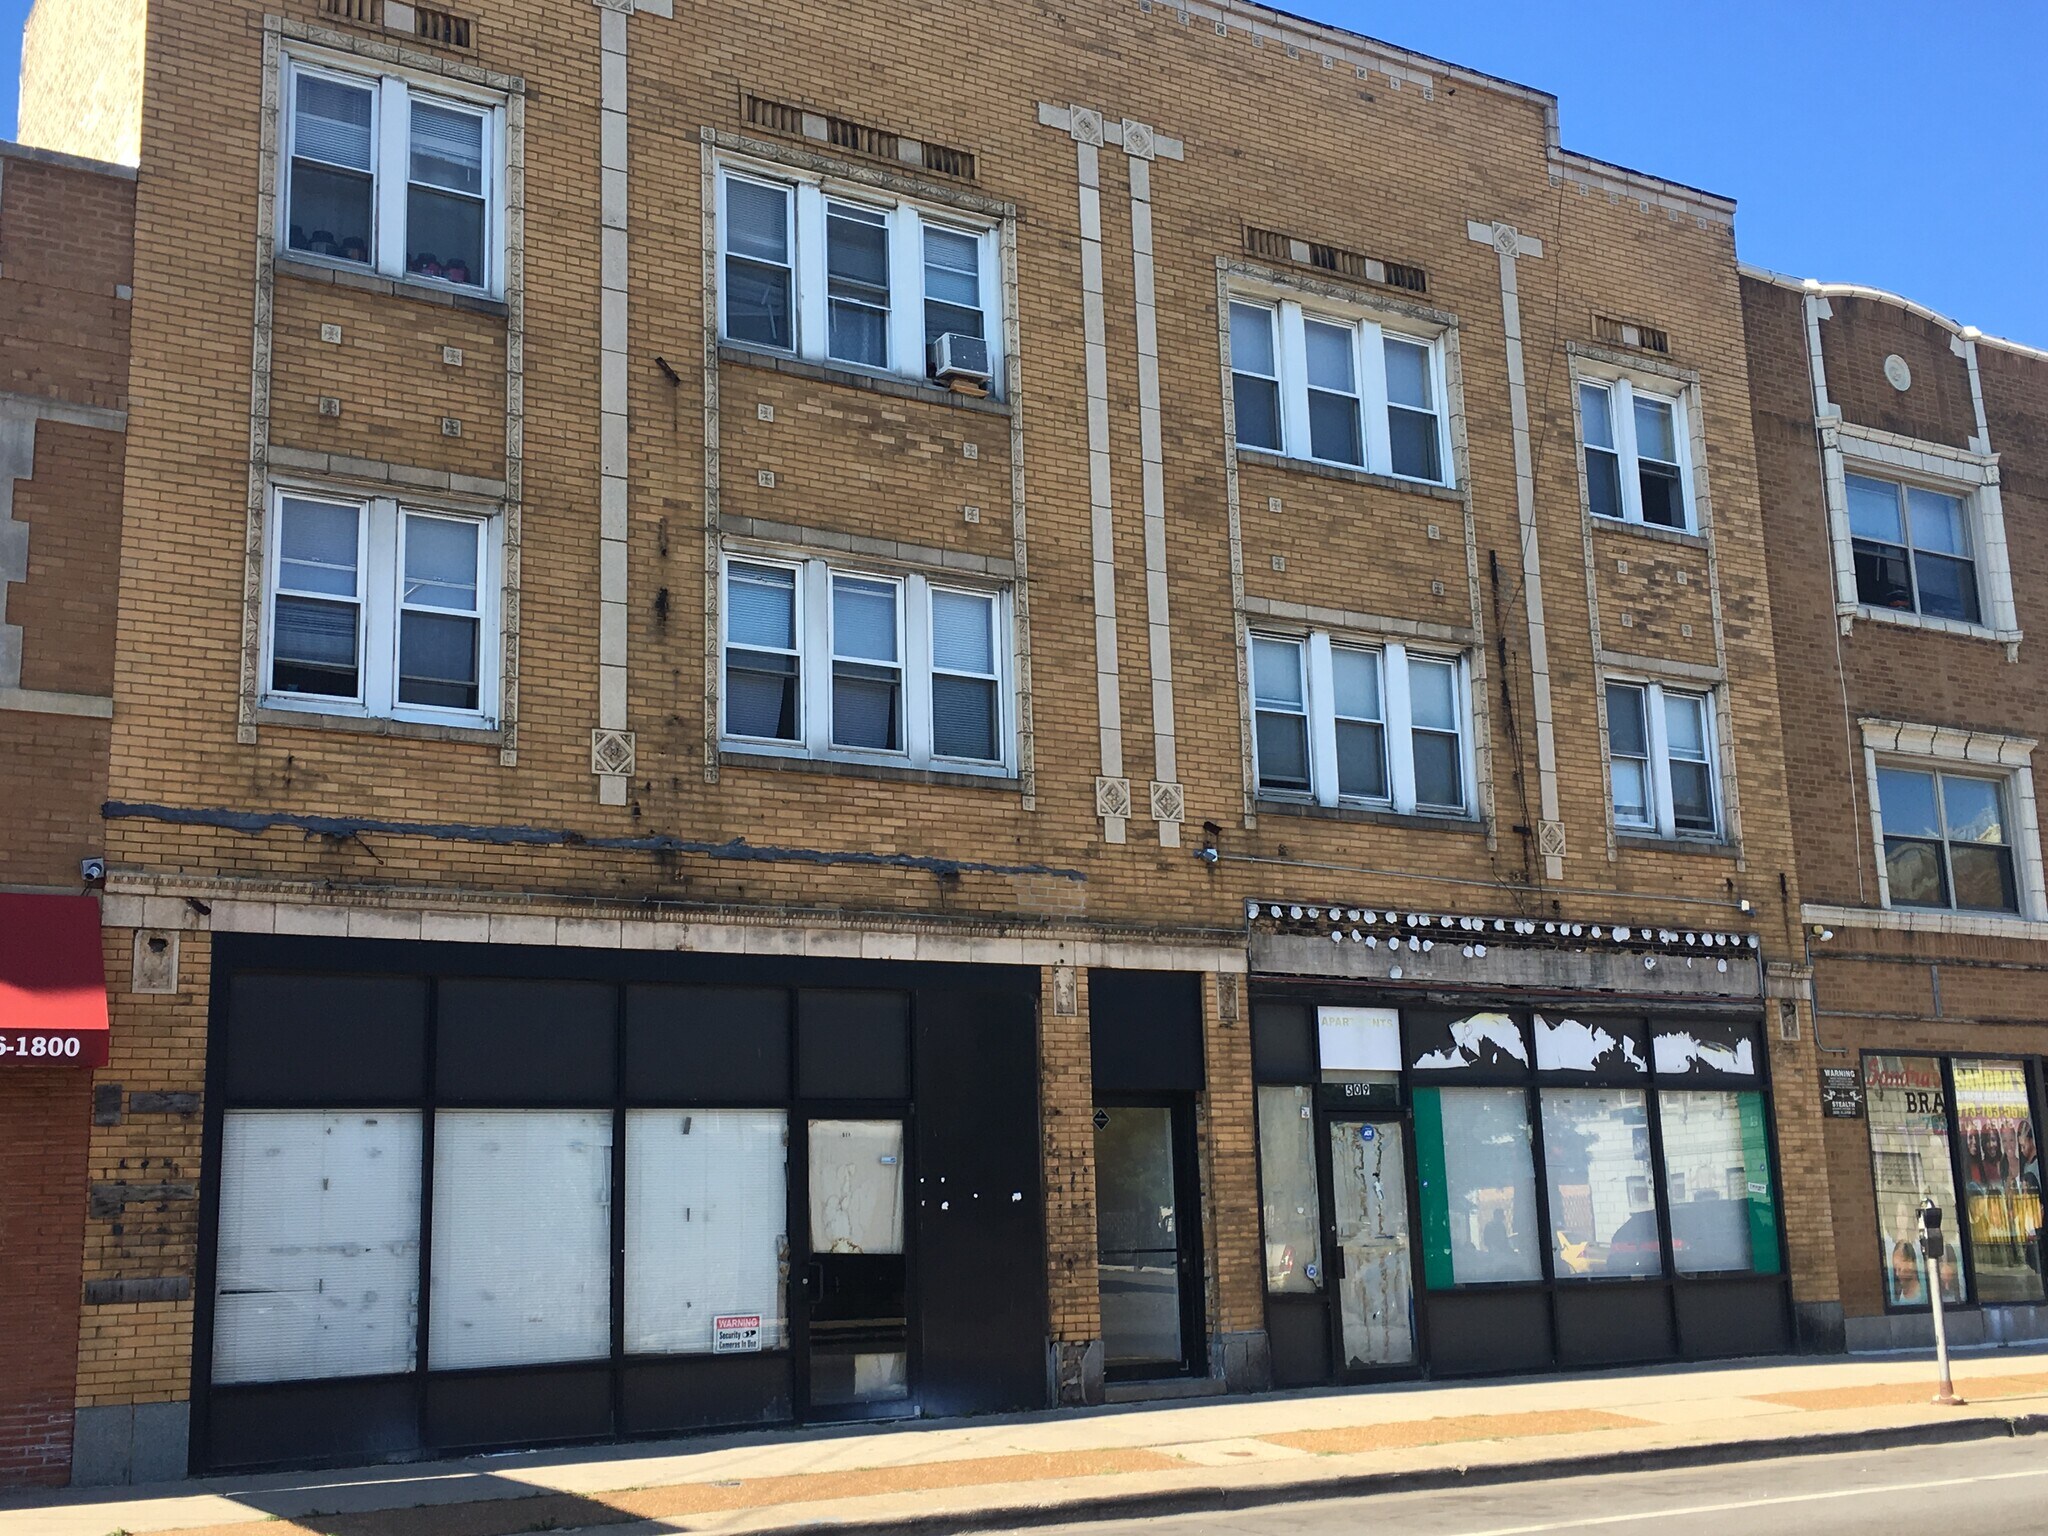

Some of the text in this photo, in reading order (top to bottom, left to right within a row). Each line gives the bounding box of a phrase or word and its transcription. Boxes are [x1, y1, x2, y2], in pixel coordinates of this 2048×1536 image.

[1322, 1017, 1393, 1027] APARNTS
[1824, 1069, 1855, 1078] WARNING
[1954, 1068, 2026, 1092] SANDRA'S
[1346, 1084, 1370, 1096] 509
[1905, 1092, 1944, 1113] BRA
[718, 1317, 758, 1328] WARNING
[719, 1331, 741, 1340] Security
[719, 1341, 741, 1350] Cameras
